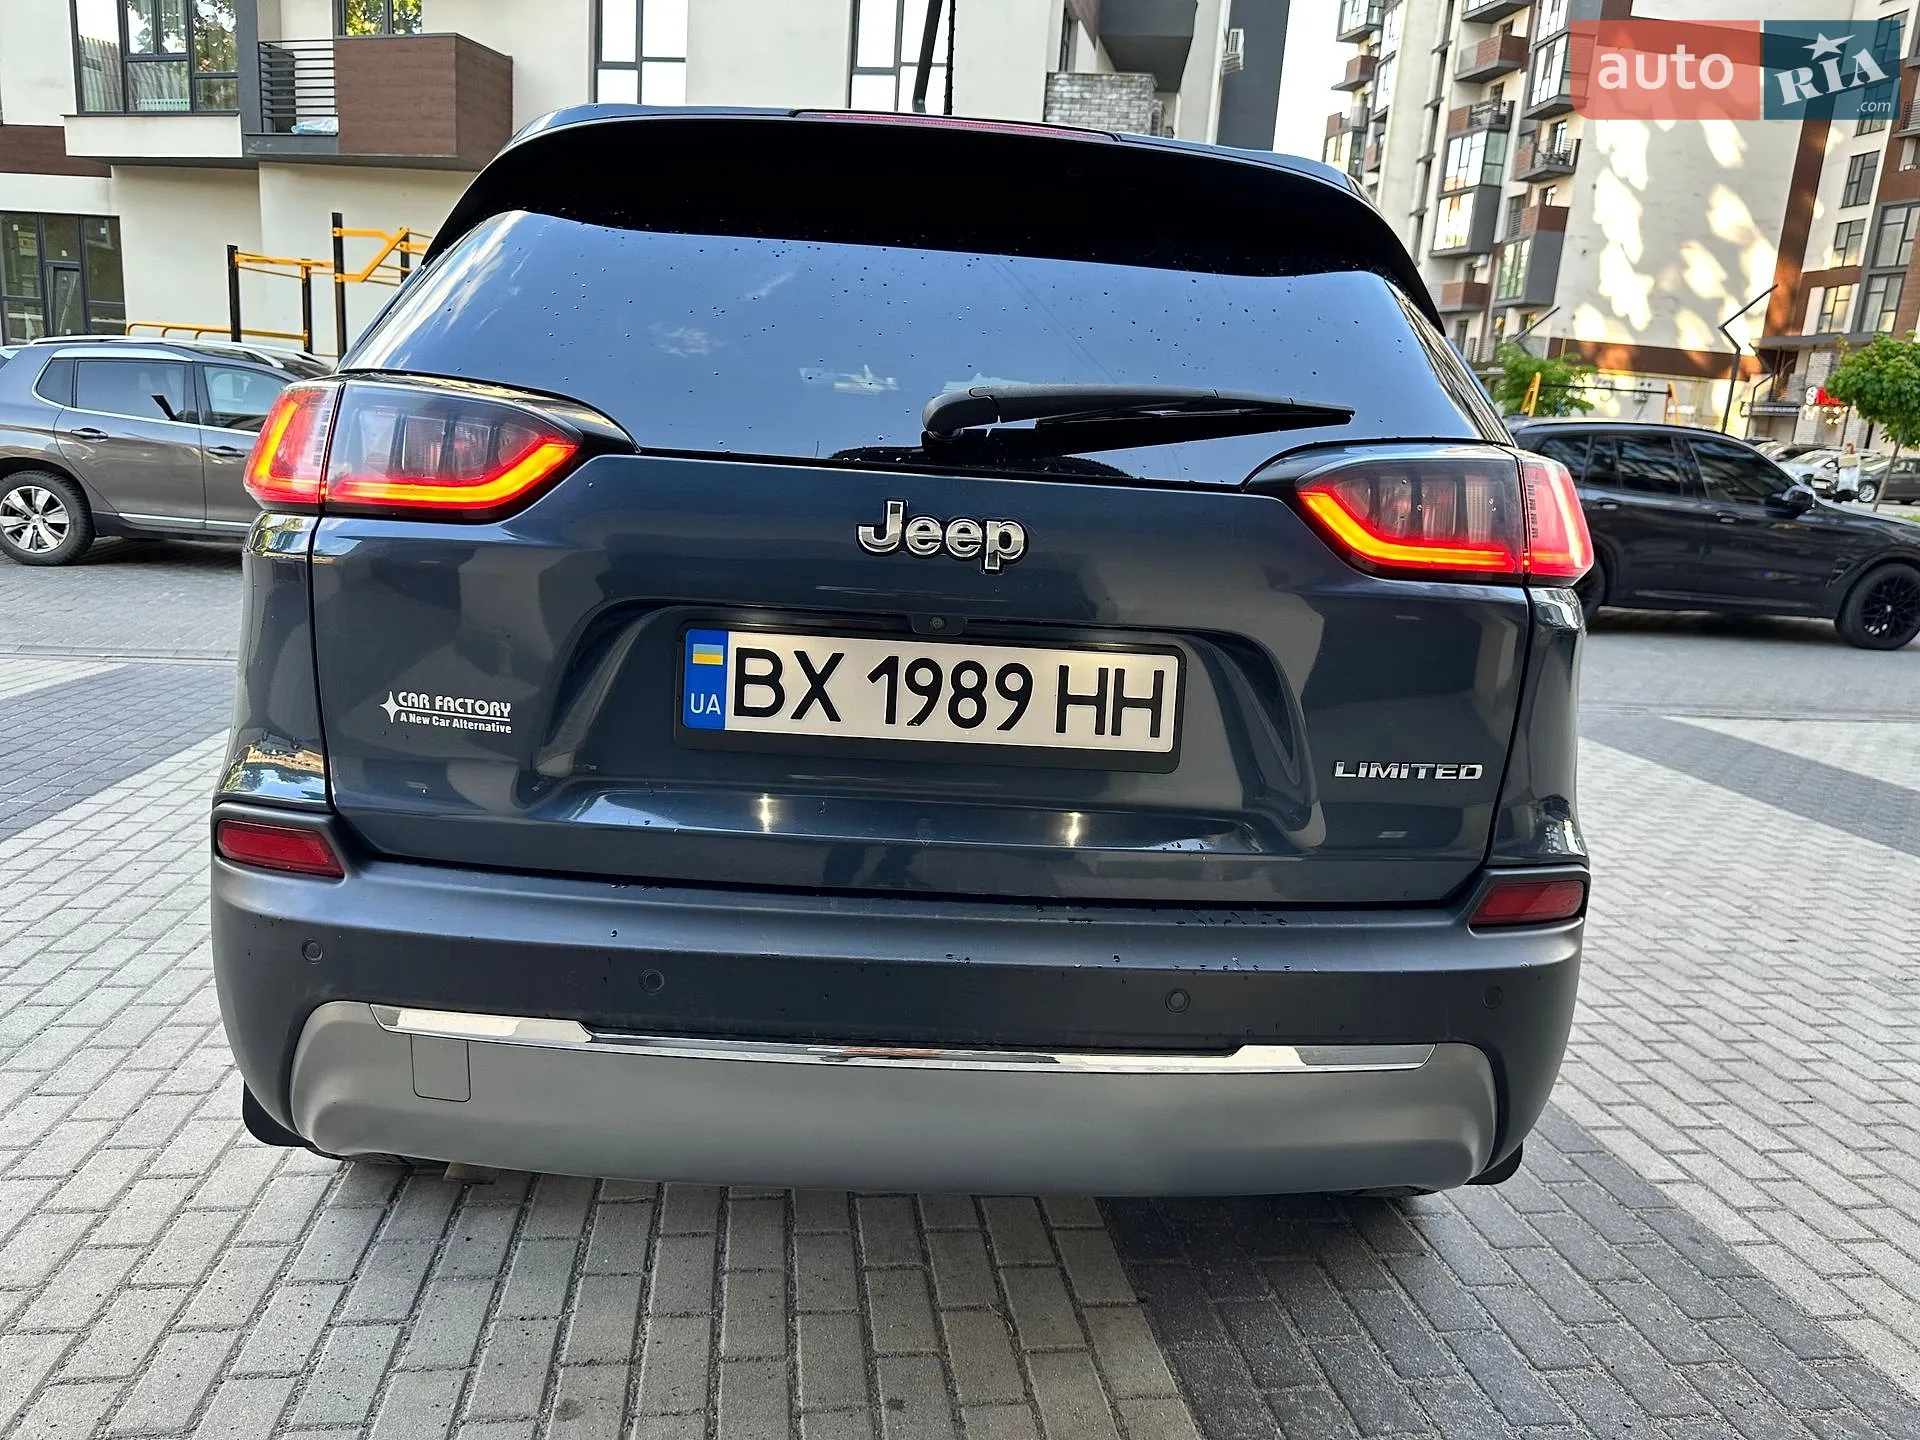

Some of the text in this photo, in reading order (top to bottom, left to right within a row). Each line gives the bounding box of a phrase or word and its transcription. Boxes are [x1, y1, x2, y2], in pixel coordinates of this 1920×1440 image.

[857, 500, 1026, 572] Jeep
[398, 691, 512, 718] CAR FACTORY
[690, 692, 722, 716] UA
[733, 646, 1165, 739] BX 1989 HH
[400, 712, 512, 734] A New Car Alternative
[1334, 761, 1484, 780] LIMITED
